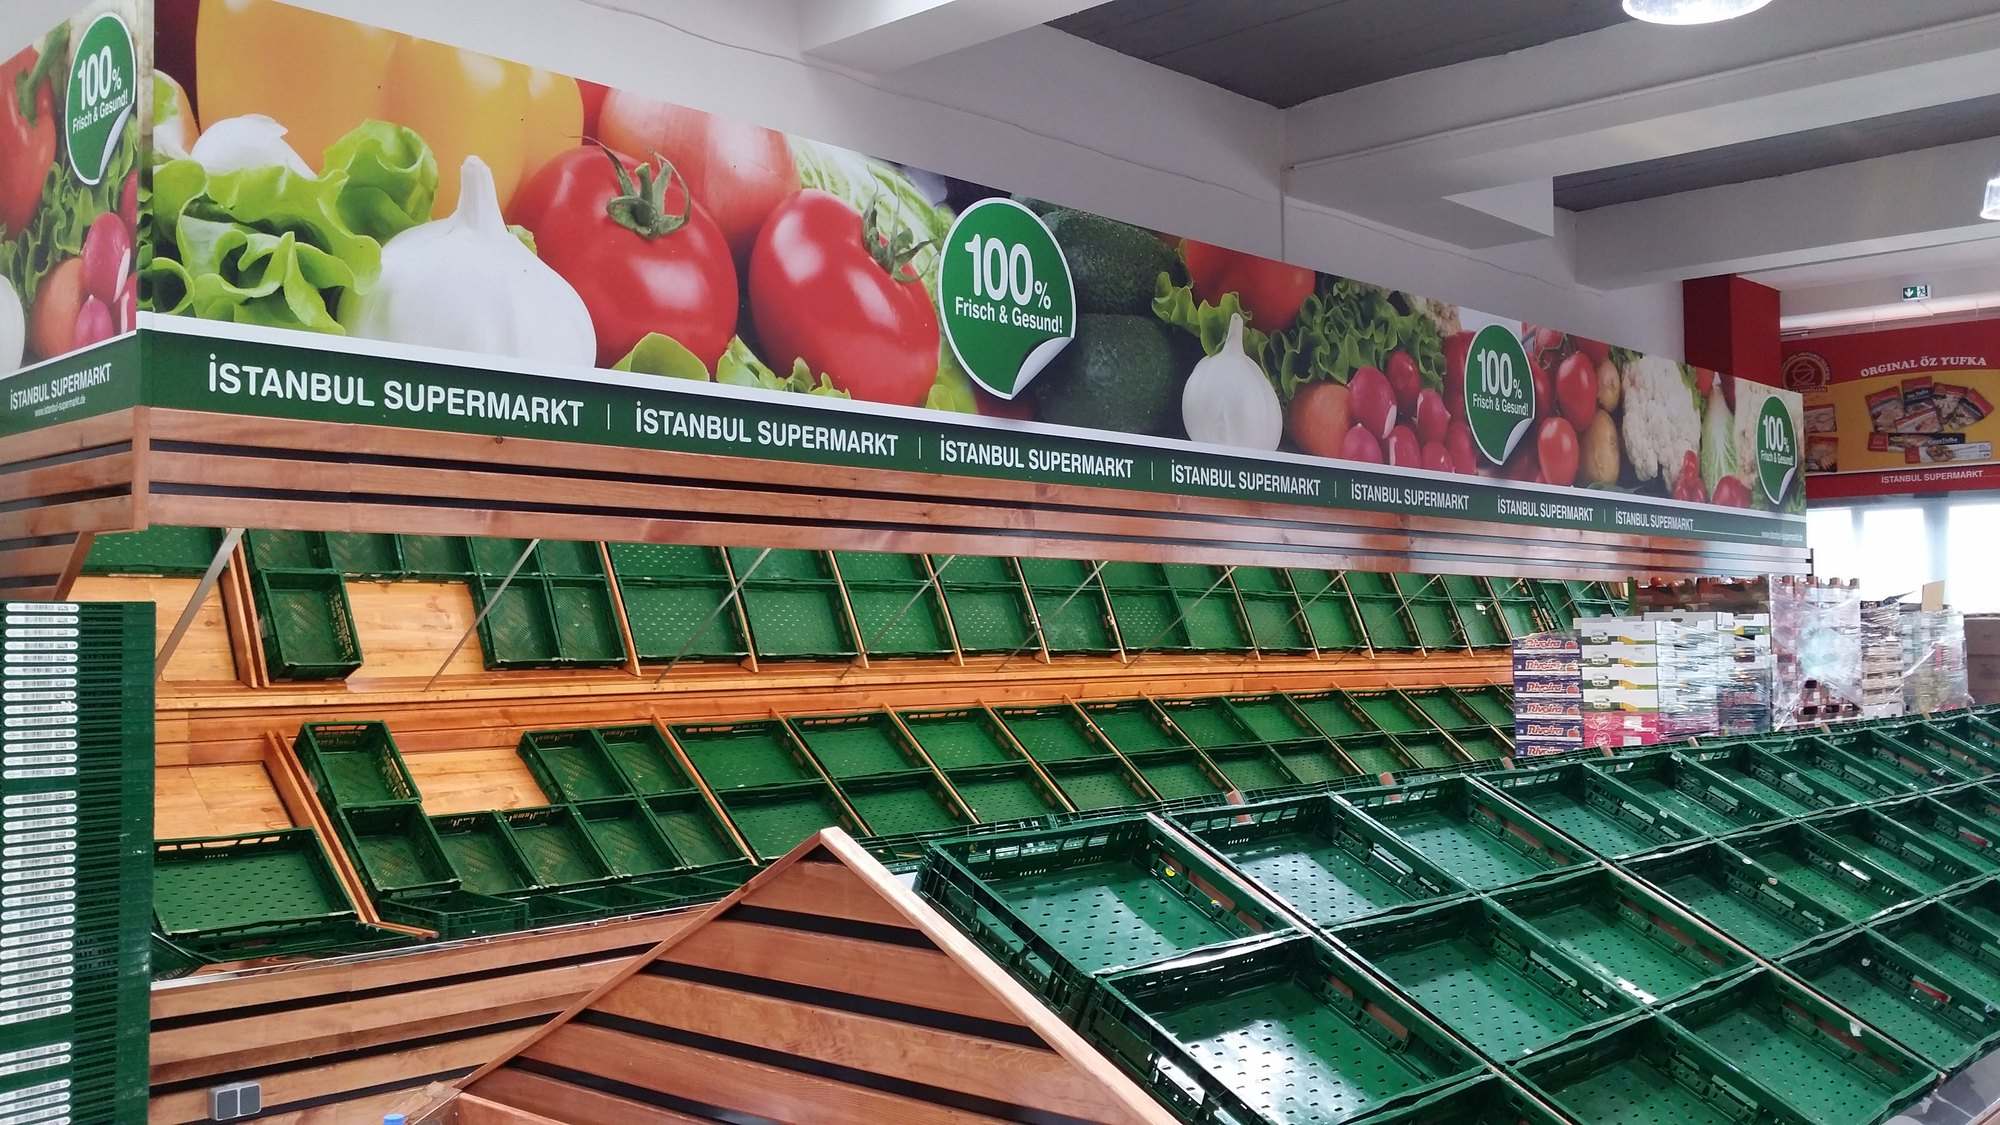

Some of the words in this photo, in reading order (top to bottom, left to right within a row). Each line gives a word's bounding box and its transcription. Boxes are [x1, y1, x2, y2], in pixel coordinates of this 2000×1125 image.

[78, 45, 122, 111] 100%
[72, 111, 93, 134] Frisch
[93, 106, 98, 122] &
[100, 88, 128, 118] Gesund!
[964, 233, 1052, 310] 100%
[955, 296, 995, 321] Frisch
[999, 304, 1008, 324] &
[1012, 306, 1063, 333] Gesund!
[51, 362, 112, 398] SUPERMARKT
[1477, 347, 1522, 399] 100%
[1860, 359, 1918, 377] ORGINAL
[1919, 356, 1938, 367] ÖZ
[1941, 356, 1987, 367] YUFKA
[383, 380, 584, 426] SUPERMARKT
[1472, 393, 1494, 410] Frisch
[1495, 398, 1500, 411] &
[1501, 399, 1529, 416] Gesund!
[757, 420, 899, 457] SUPERMARKT
[1028, 448, 1134, 478] SUPERMARKT
[1924, 470, 1984, 481] SUPERMARKT
[1238, 471, 1321, 496] SUPERMARKT
[1404, 488, 1469, 511] SUPERMARKT
[1540, 504, 1594, 522] SUPERMARKT
[1650, 513, 1694, 532] SUPERMARKT
[1527, 724, 1564, 736] Rivoira
